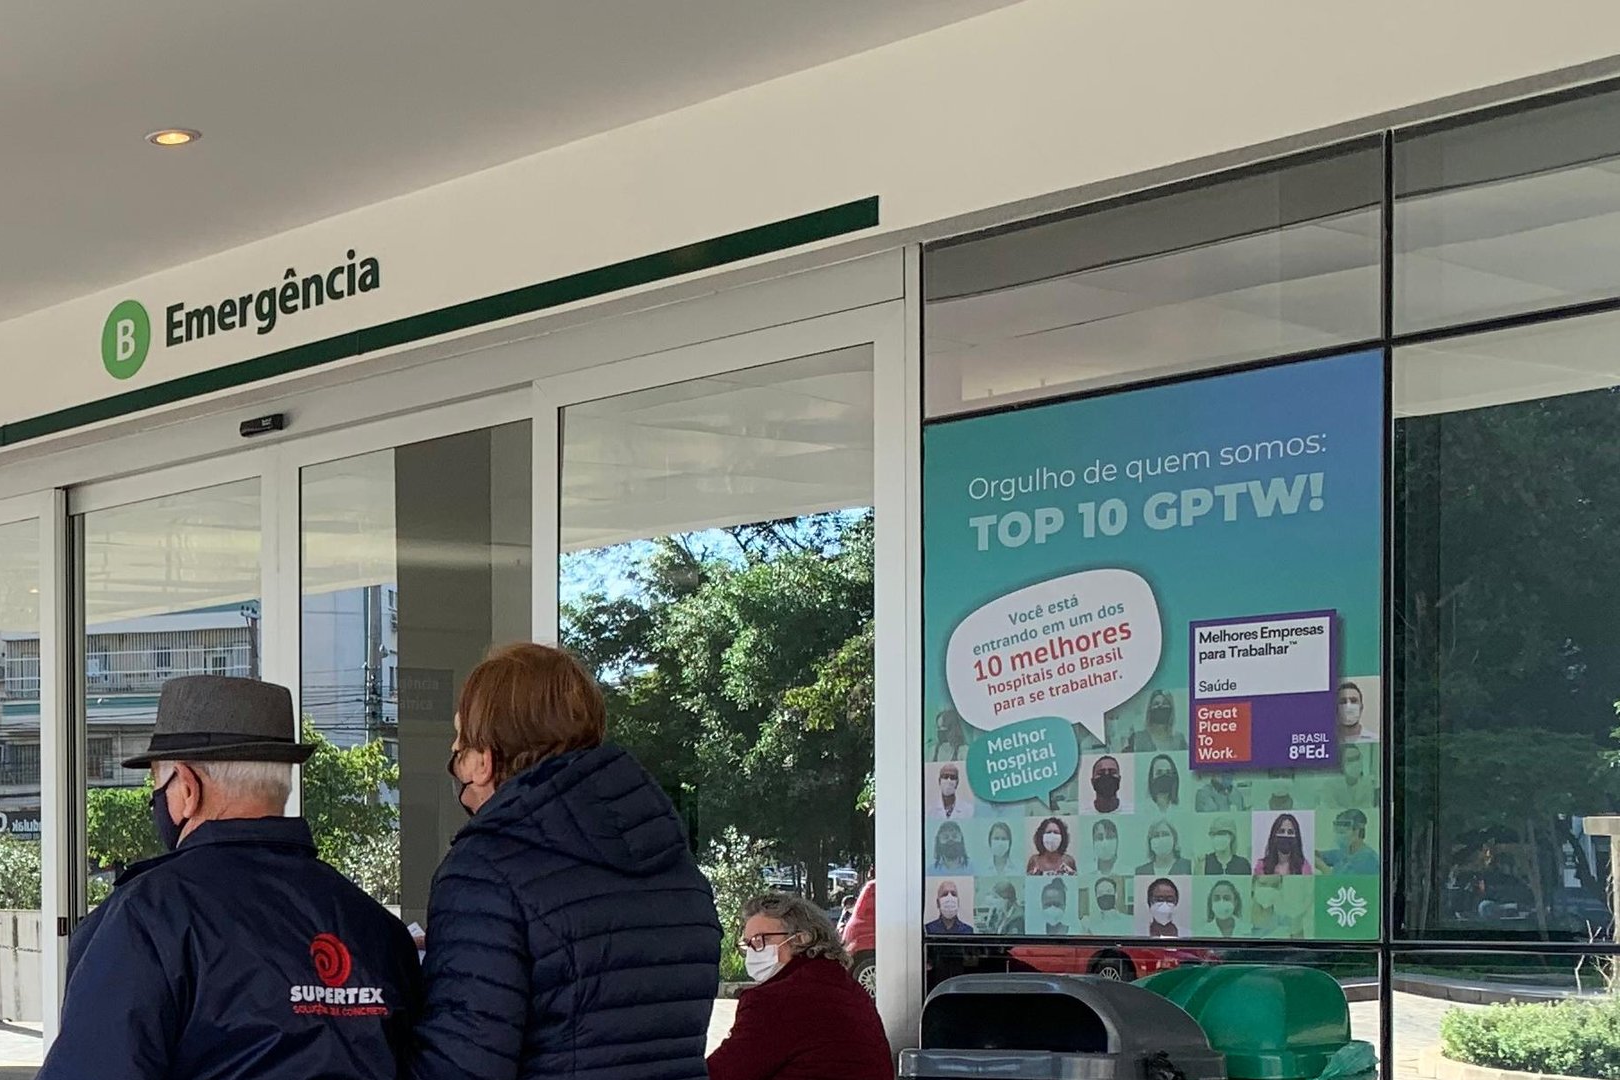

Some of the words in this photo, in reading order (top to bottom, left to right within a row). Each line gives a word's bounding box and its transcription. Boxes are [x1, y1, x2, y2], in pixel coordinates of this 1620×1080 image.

[116, 319, 135, 362] B
[166, 249, 380, 348] Emergência
[969, 467, 1076, 502] Orgulho
[1083, 459, 1118, 485] de
[1126, 450, 1211, 482] quem
[1220, 433, 1327, 466] somos:
[969, 507, 1065, 551] TOP
[1078, 498, 1128, 538] 10
[1143, 472, 1325, 531] GPTW!
[1008, 605, 1044, 625] Você
[1048, 594, 1079, 614] está
[973, 628, 1038, 656] entrando
[1042, 621, 1065, 635] em
[1069, 612, 1093, 627] um
[1097, 602, 1125, 619] dos
[1199, 629, 1258, 644] Melhores
[1260, 625, 1324, 641] Empresas
[973, 655, 1003, 682] 10
[1010, 622, 1132, 671] melhores
[1199, 650, 1226, 664] para
[988, 667, 1053, 696] hospitais
[1057, 661, 1076, 676] do
[1080, 647, 1124, 670] Brasil
[1198, 679, 1237, 692] Saúde
[994, 696, 1025, 715] para
[1029, 690, 1045, 703] se
[1048, 669, 1124, 698] trabalhar.
[1198, 707, 1238, 720] Great
[1199, 721, 1237, 733] Place
[987, 728, 1047, 755] Melhor
[1198, 735, 1213, 746] To
[1291, 733, 1329, 744] BRASIL
[986, 742, 1056, 774] hospital
[990, 761, 1058, 796] público!
[290, 985, 385, 1004] SUPERTEX
